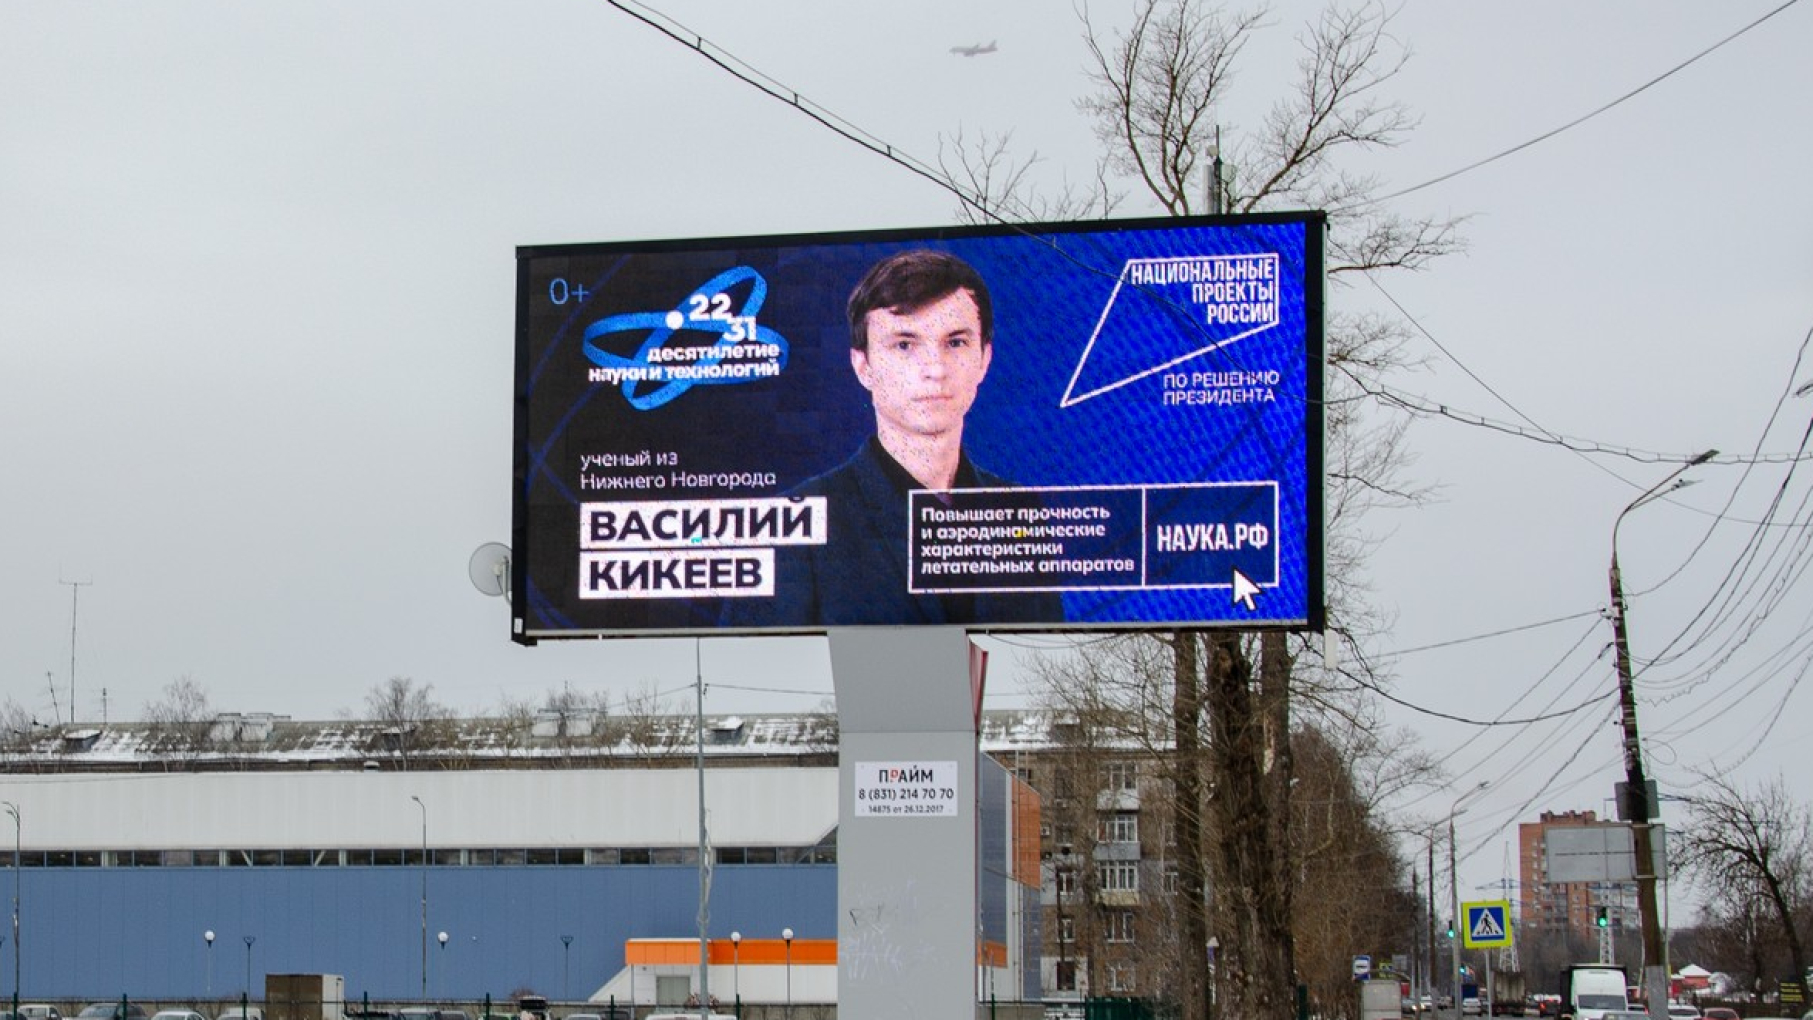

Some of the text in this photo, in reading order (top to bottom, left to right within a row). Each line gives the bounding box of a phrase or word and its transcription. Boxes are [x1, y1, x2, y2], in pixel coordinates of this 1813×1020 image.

[1130, 258, 1273, 285] НАЦИОНАЛЬНЫЕ
[549, 277, 589, 305] 0+
[1192, 281, 1273, 304] ПРОЕКТЫ
[689, 292, 732, 321] 22
[1206, 303, 1274, 325] РОССИИ
[722, 315, 757, 342] 31
[647, 343, 780, 363] десятилетие
[588, 359, 780, 386] науки и технологий
[1163, 371, 1280, 388] ПО РЕШЕНИЮ
[1163, 388, 1275, 406] ПРЕЗИДЕНТА
[580, 450, 679, 471] ученый из
[580, 470, 777, 490] Нижнего Новгорода
[590, 496, 813, 542] ВАСИЛИЙ
[921, 506, 1111, 524] Повышает прочность
[921, 524, 1106, 542] и аэродинамические
[1157, 522, 1269, 551] НАУКА.РФ
[921, 542, 1063, 560] характеристики
[590, 558, 762, 591] КИКЕЕВ
[921, 558, 1135, 576] летательных аппаратов
[879, 765, 933, 783] ПРАЙМ
[859, 788, 954, 801] 8 (831) 214 70 70
[869, 805, 891, 813] 14875
[904, 805, 944, 813] 26.12.2017
